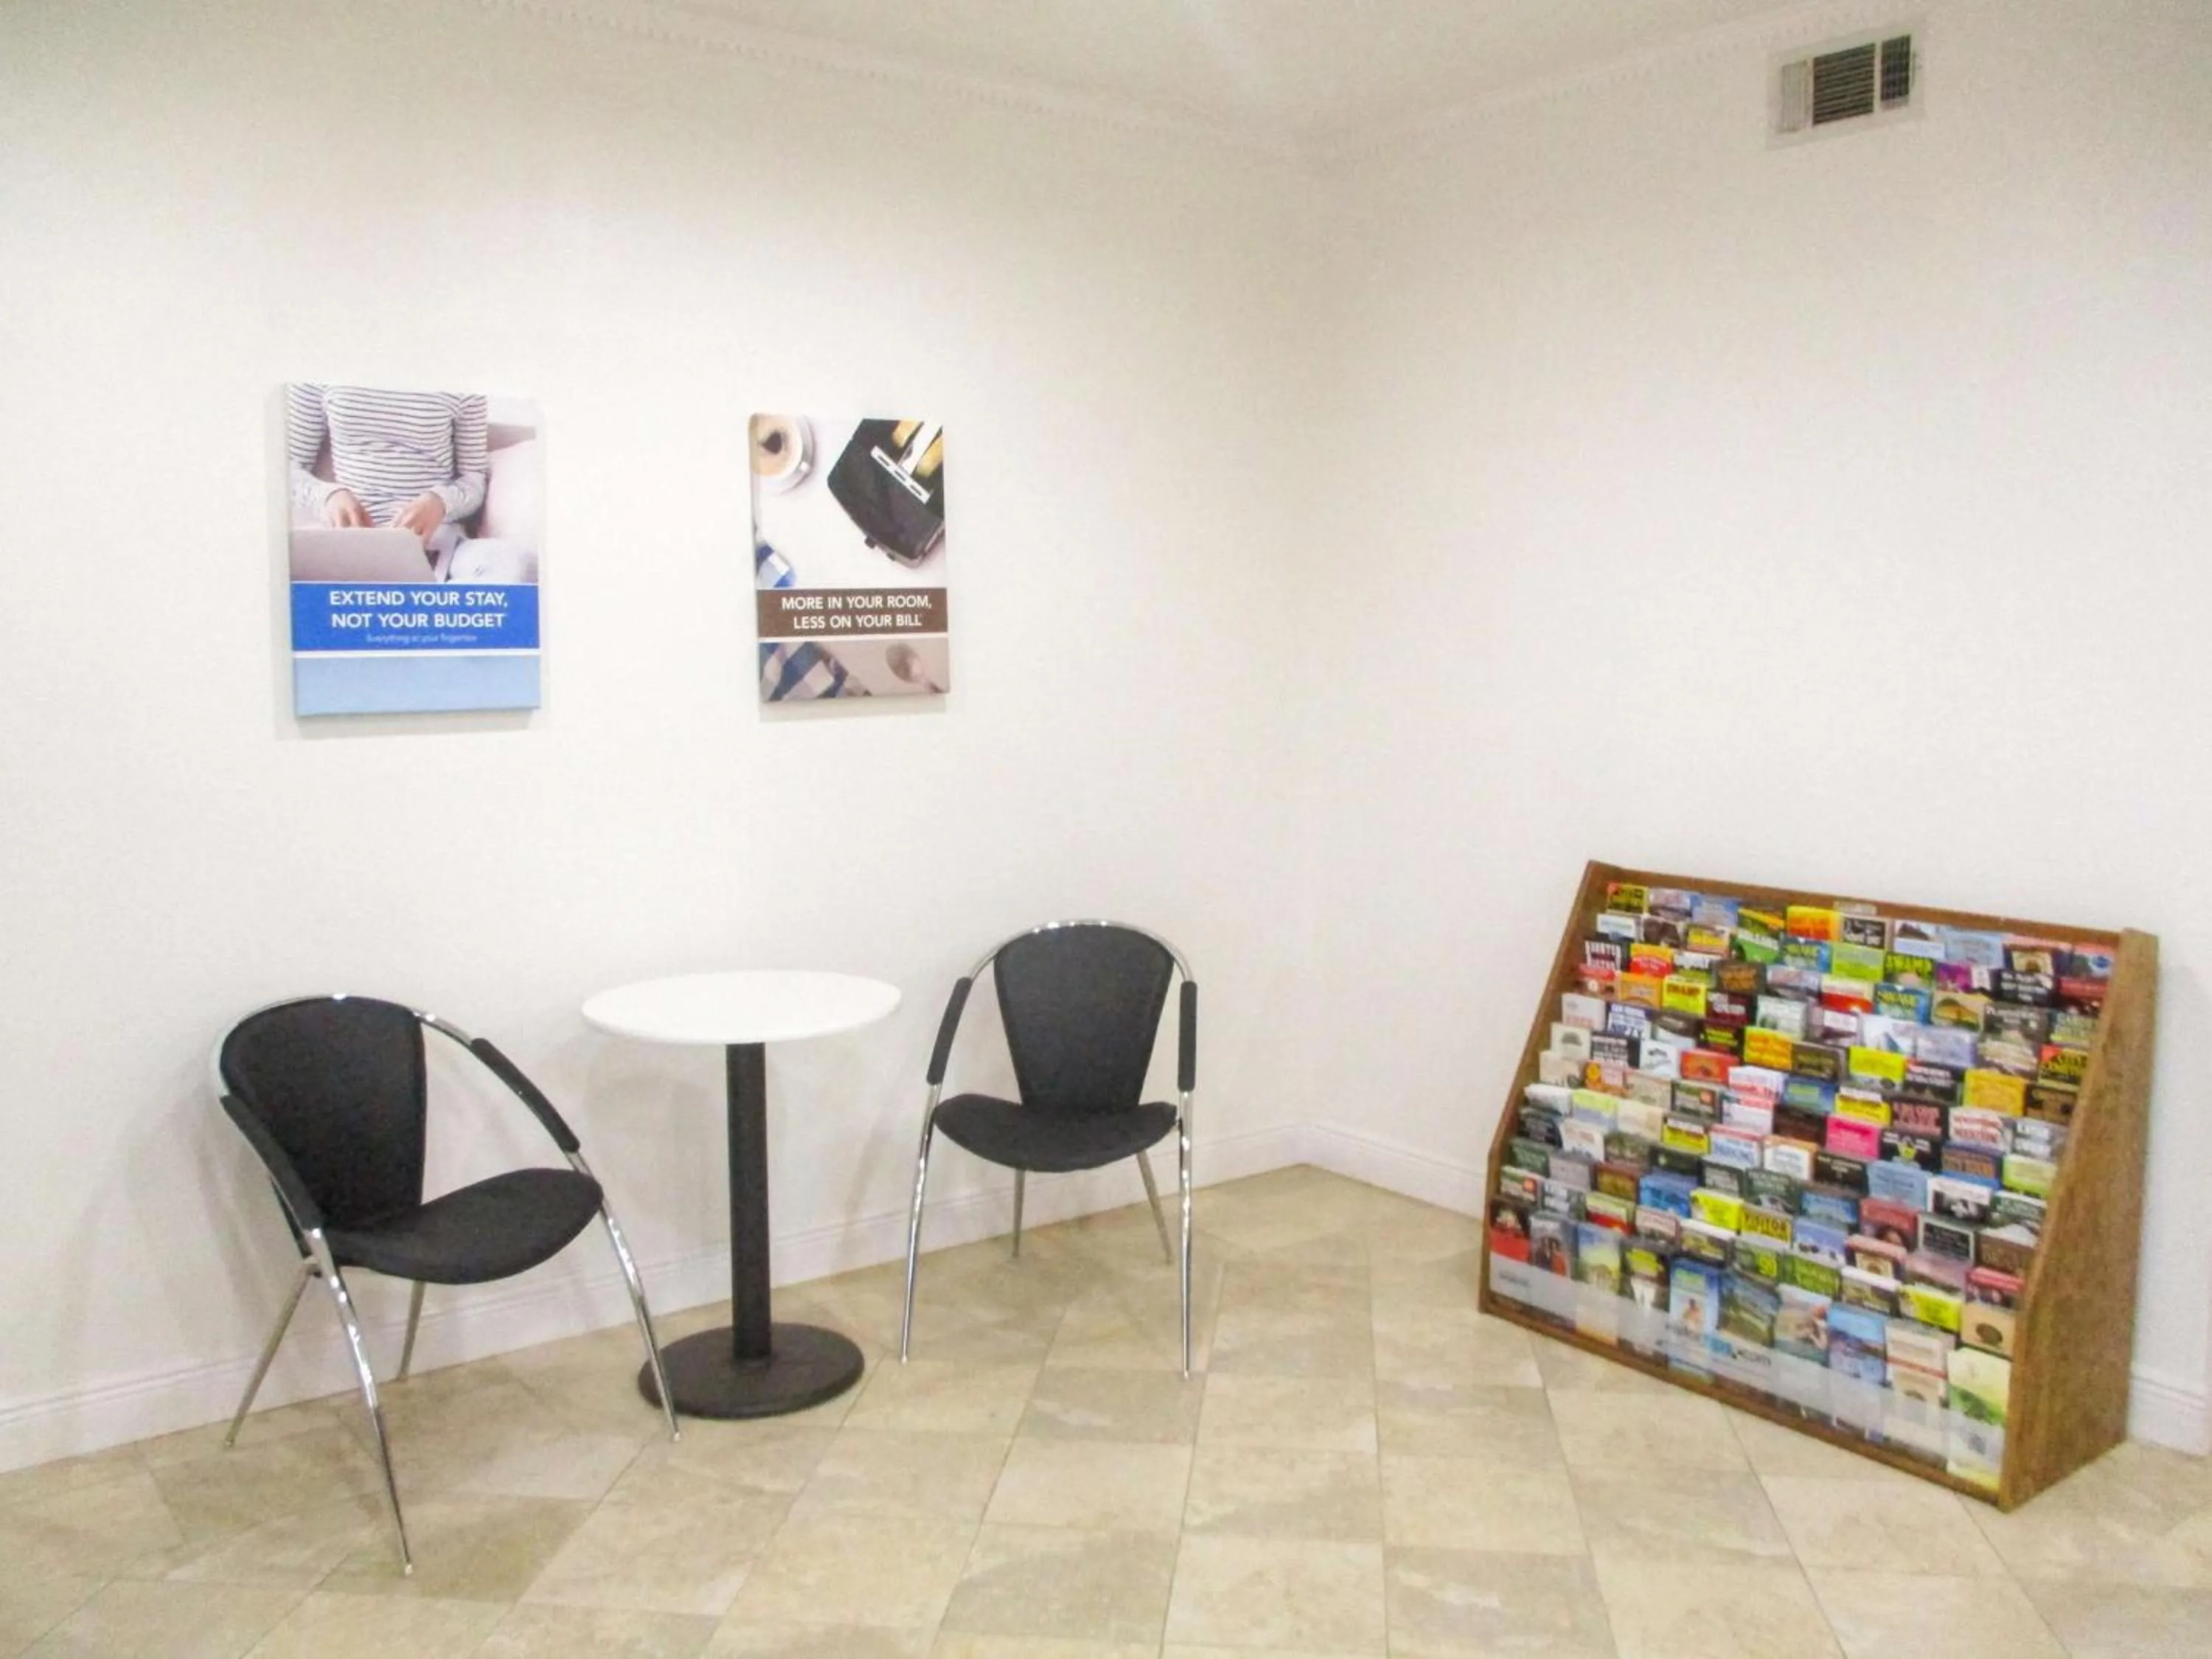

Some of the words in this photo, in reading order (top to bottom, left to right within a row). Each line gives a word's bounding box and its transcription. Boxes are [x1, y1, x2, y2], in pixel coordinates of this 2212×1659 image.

[330, 591, 405, 606] EXTEND
[410, 591, 460, 606] YOUR
[465, 591, 509, 608] STAY,
[782, 597, 824, 611] MORE
[828, 597, 842, 610] IN
[847, 596, 883, 609] YOUR
[887, 595, 933, 610] ROOM,
[332, 613, 372, 627] NOT
[378, 613, 428, 627] YOUR
[434, 613, 504, 627] BUDGET
[793, 616, 826, 630] LESS
[830, 615, 852, 628] ON
[855, 614, 892, 627] YOUR
[897, 613, 922, 626] BILL
